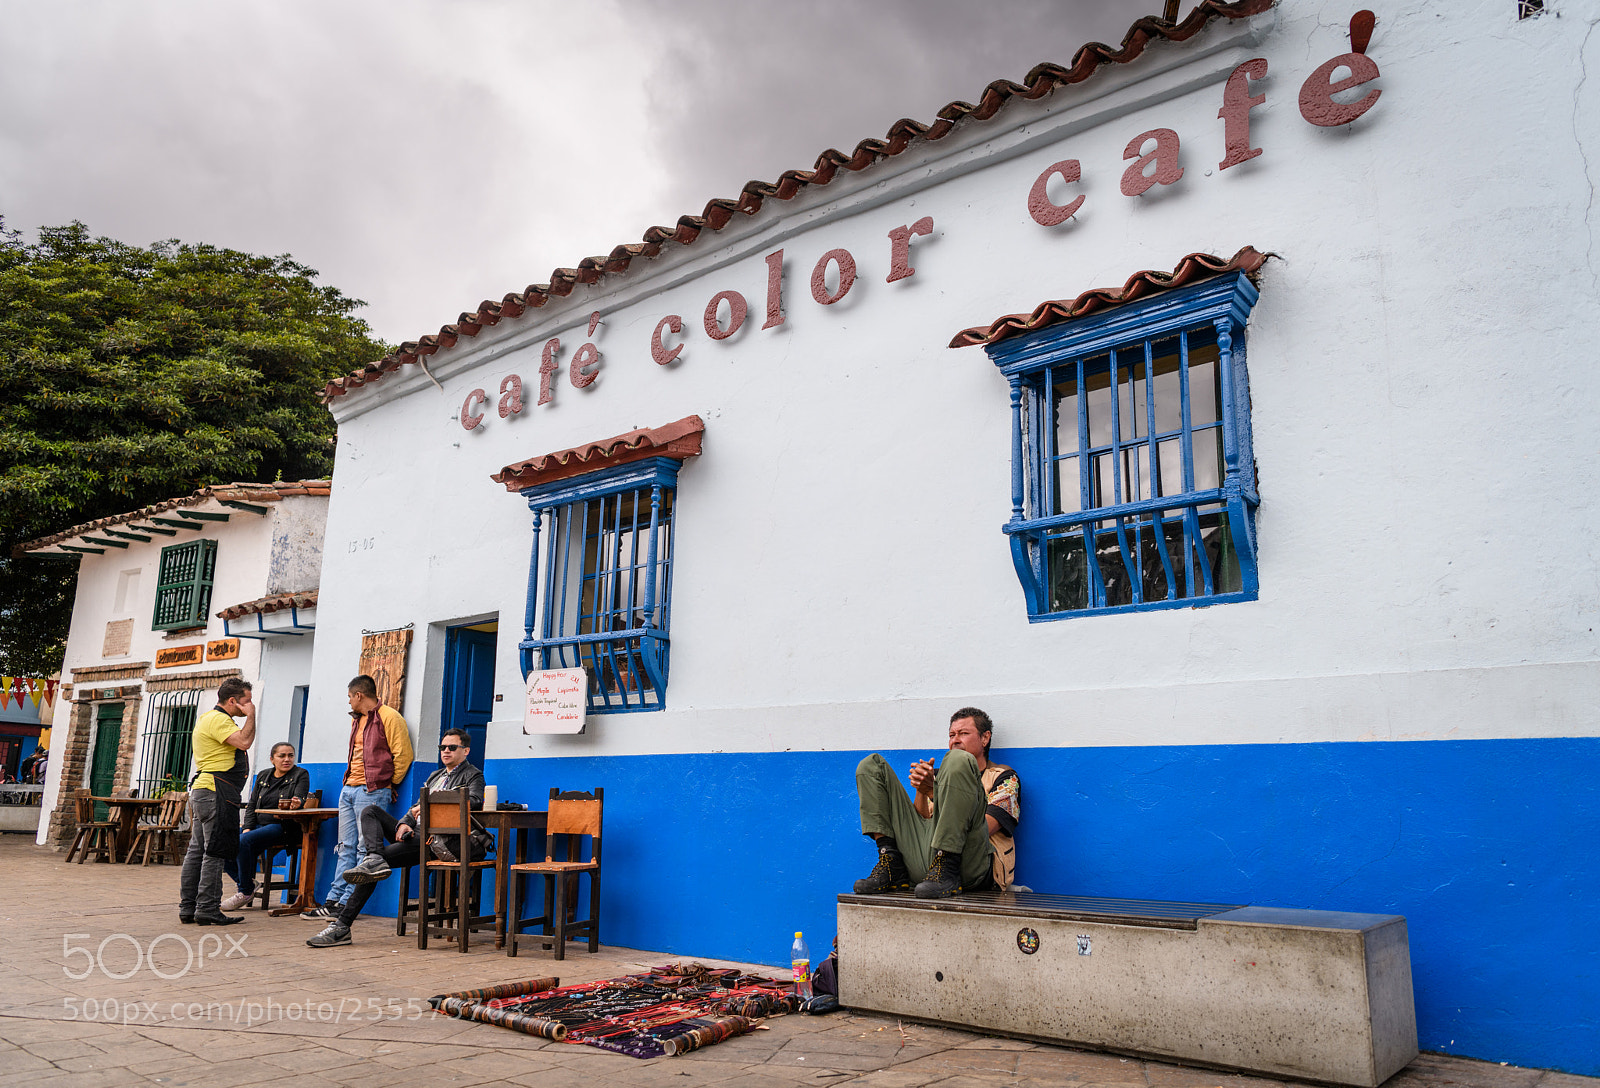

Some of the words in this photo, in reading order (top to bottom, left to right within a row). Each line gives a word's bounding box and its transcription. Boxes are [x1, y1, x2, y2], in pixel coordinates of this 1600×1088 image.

[461, 311, 600, 430] café
[651, 216, 934, 365] color
[1028, 10, 1382, 226] café
